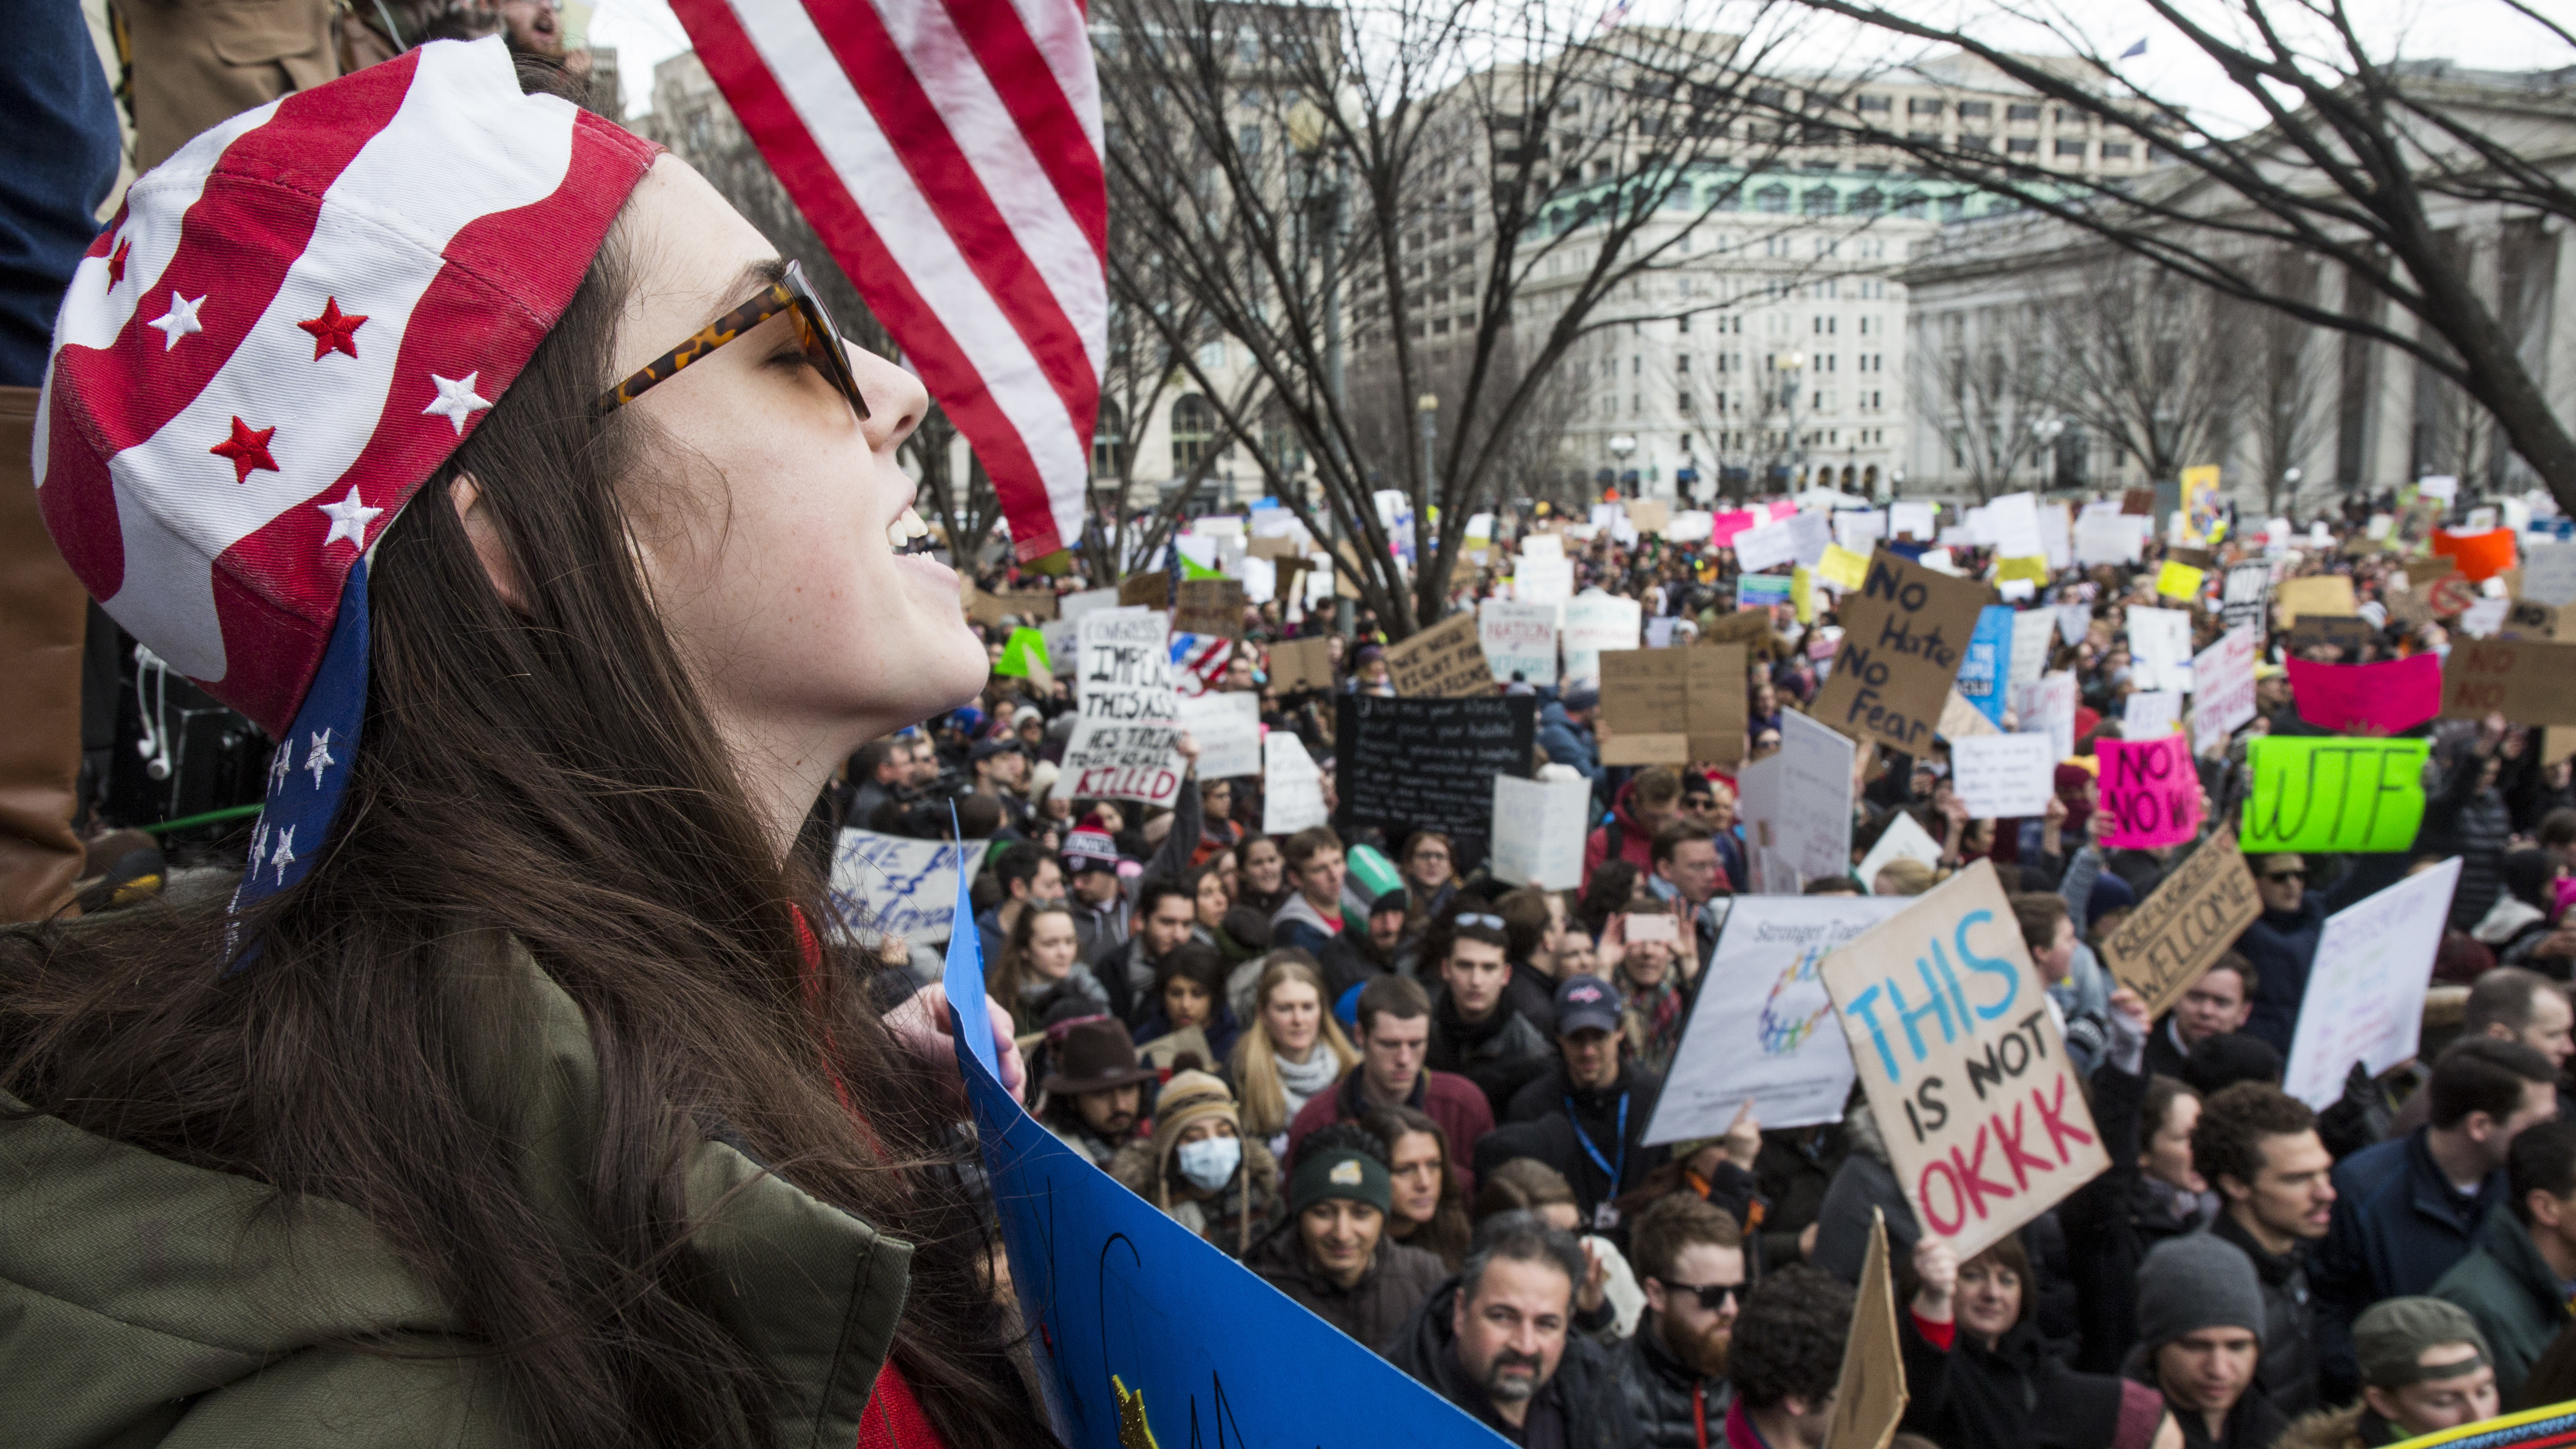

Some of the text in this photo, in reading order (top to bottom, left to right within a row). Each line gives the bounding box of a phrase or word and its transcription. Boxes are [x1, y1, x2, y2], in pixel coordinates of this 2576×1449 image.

[1879, 612, 1957, 669] Hate
[1085, 692, 1140, 719] THIS
[1846, 687, 1928, 746] Fear
[1075, 766, 1177, 800] KILLED
[2116, 741, 2173, 788] NO
[2110, 791, 2160, 834] NO
[2247, 746, 2418, 845] WTF
[843, 836, 911, 868] THE
[1752, 919, 1825, 945] Stronger
[2111, 849, 2223, 962] REFUGEES
[2121, 866, 2258, 1002] WELCOME
[1846, 908, 2020, 1084] THIS
[1904, 1076, 1950, 1144] IS
[1965, 1010, 2048, 1099] NOT
[1918, 1073, 2094, 1238] OKKK
